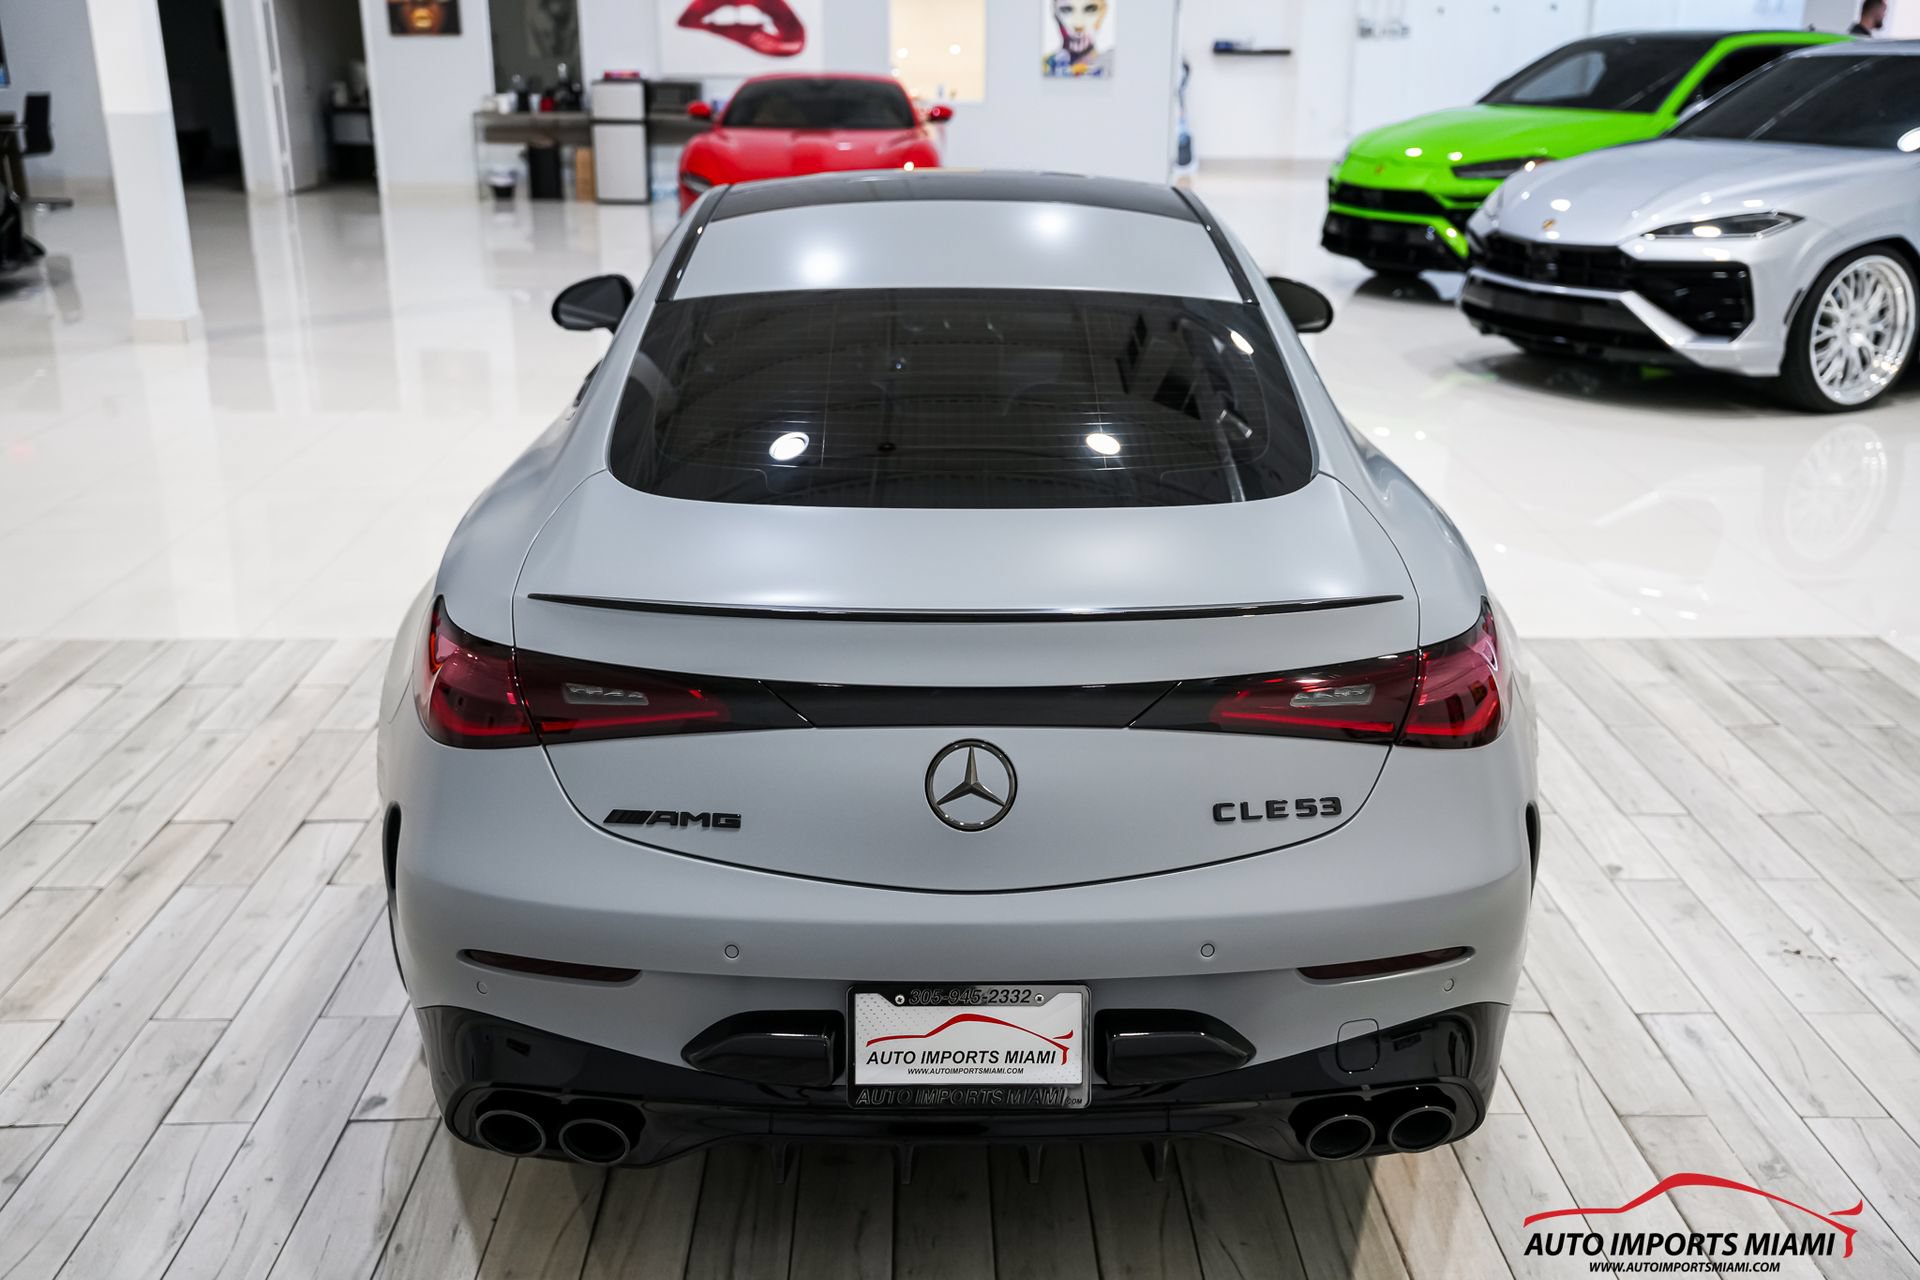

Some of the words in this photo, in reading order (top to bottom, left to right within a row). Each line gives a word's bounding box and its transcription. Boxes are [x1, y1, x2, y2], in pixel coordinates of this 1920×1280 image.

[909, 988, 1032, 1005] 305-945-2332
[866, 1050, 916, 1065] AUTO
[920, 1050, 1000, 1065] IMPORTS
[1004, 1050, 1057, 1064] MIAMI
[907, 1067, 1024, 1075] WWW.AUTOIMPORTSMIAMI.COM
[856, 1087, 913, 1105] AUTO
[915, 1087, 1004, 1105] IMPORTS
